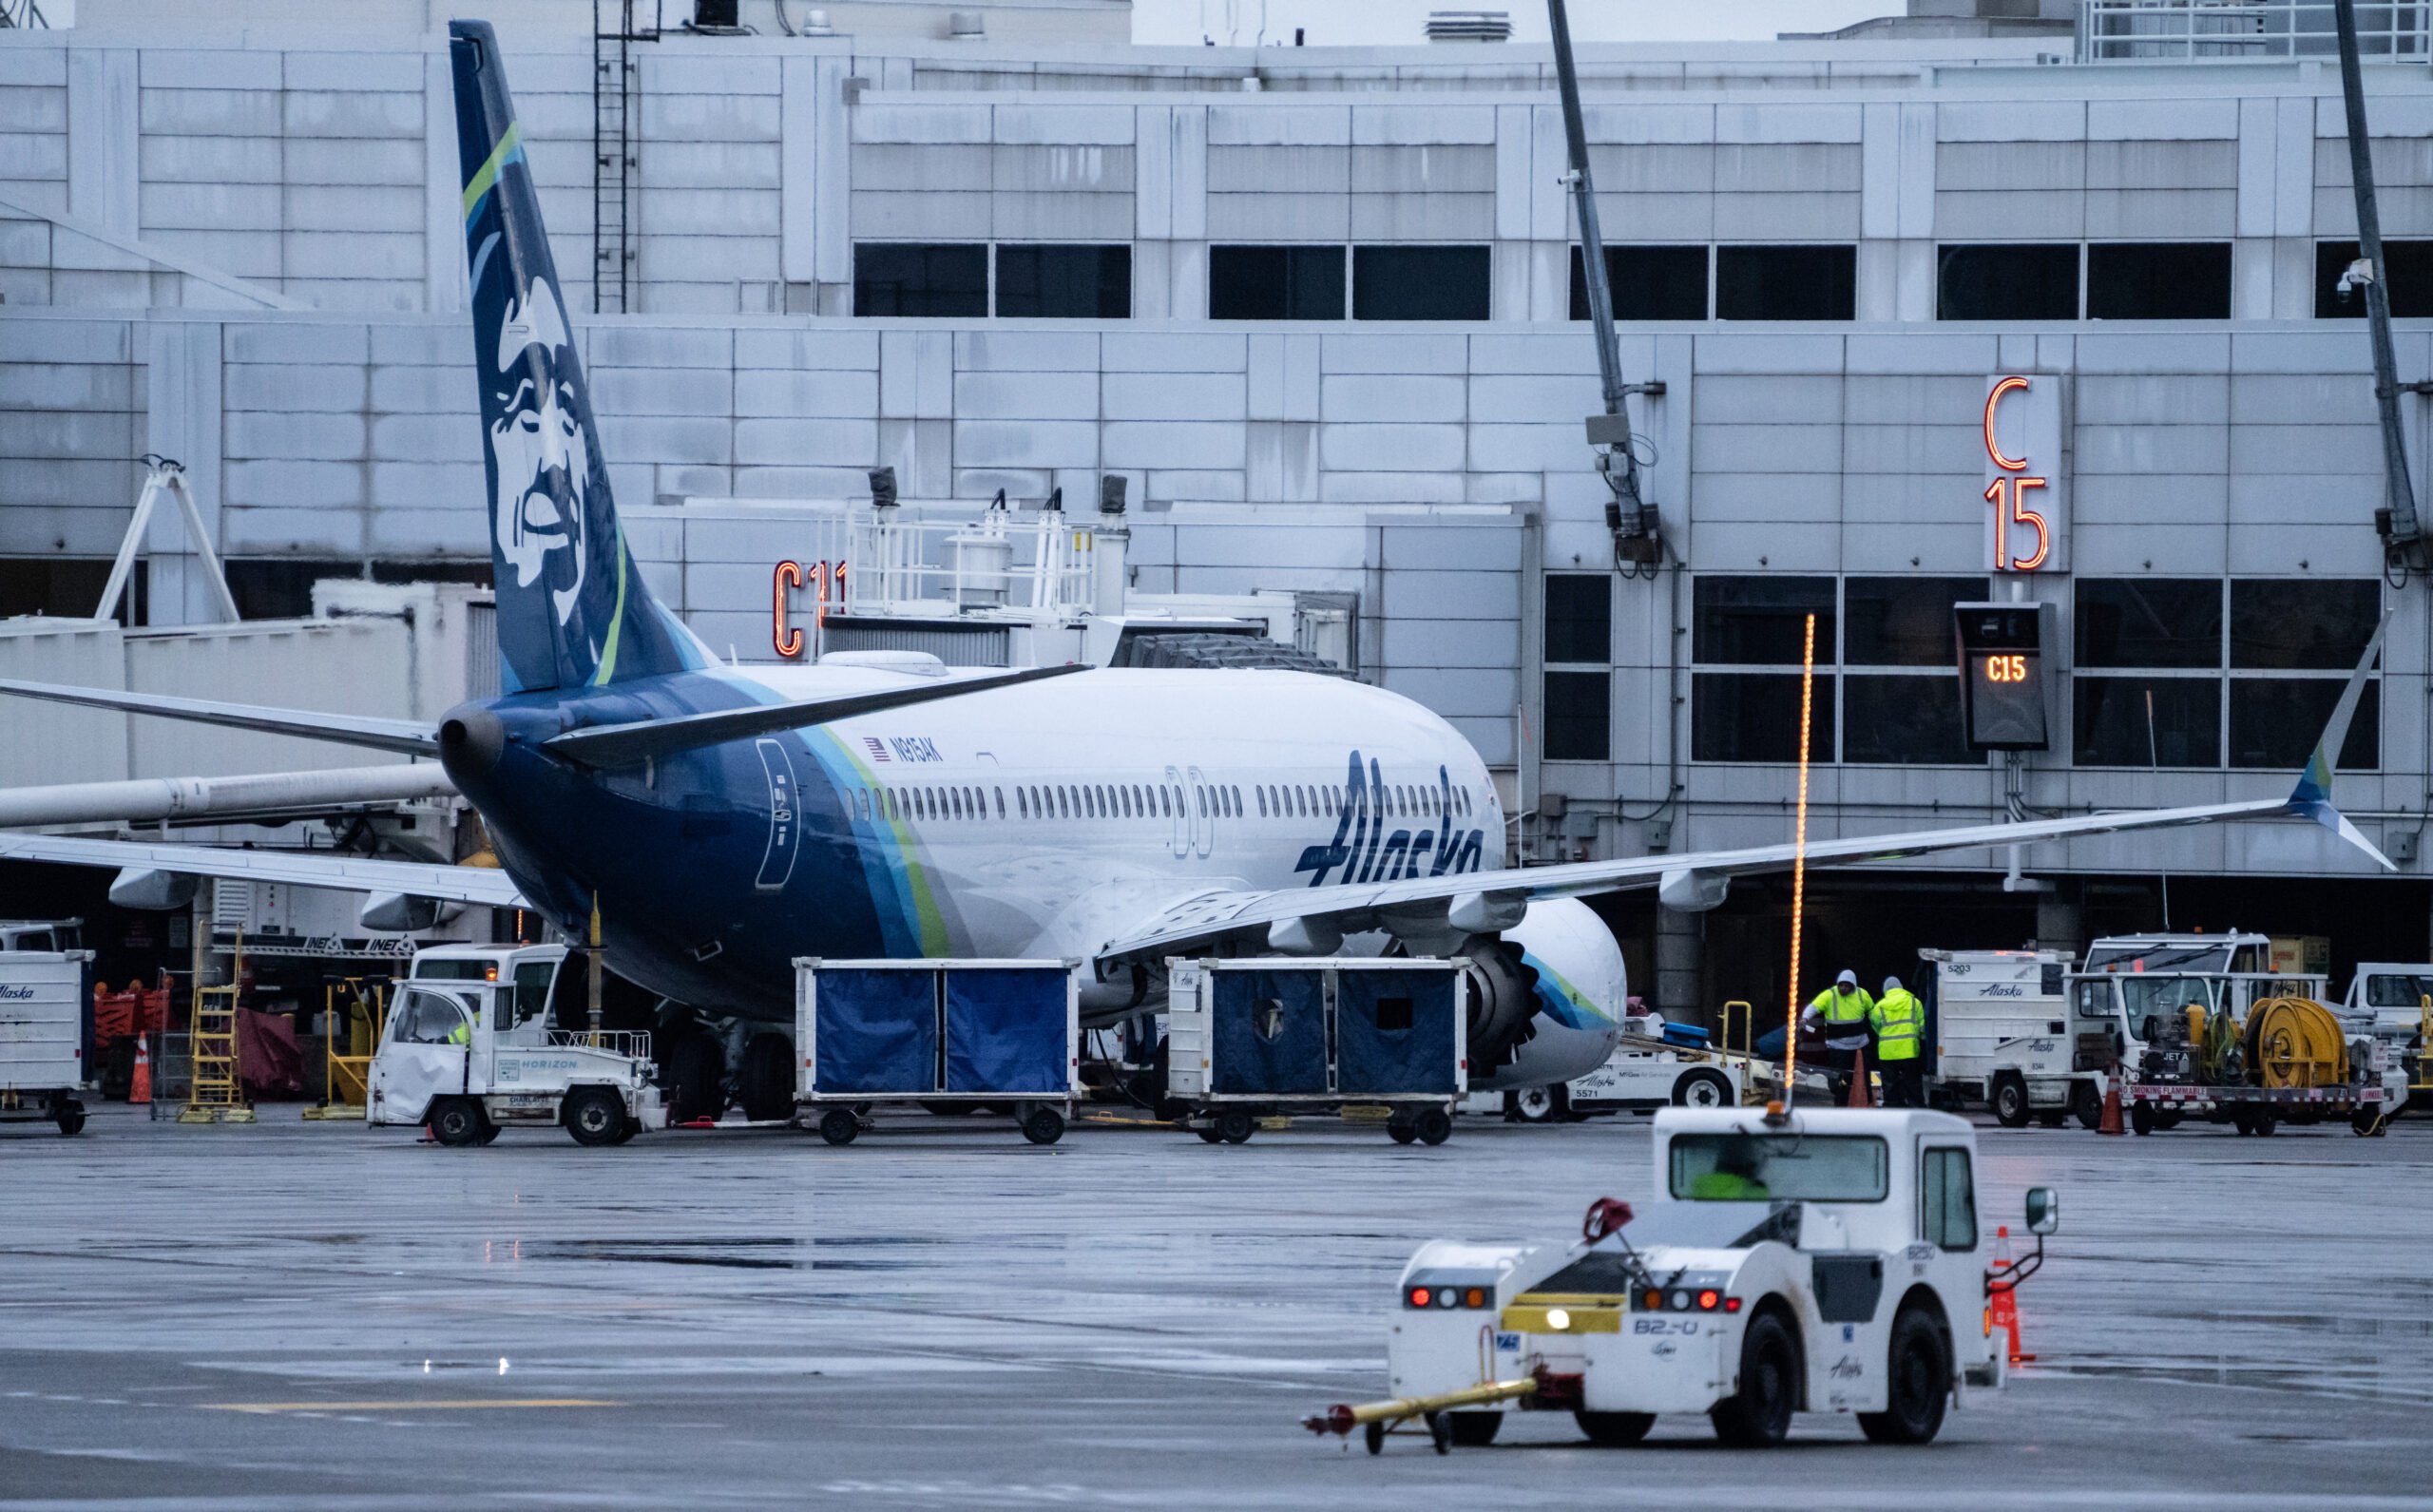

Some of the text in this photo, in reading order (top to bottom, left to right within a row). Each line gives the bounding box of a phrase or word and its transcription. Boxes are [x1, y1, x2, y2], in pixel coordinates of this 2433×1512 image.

[1984, 376, 2028, 470] C
[1984, 477, 2049, 570] 15
[1986, 656, 2026, 681] C15
[889, 737, 943, 762] N915AK
[0, 985, 34, 1000] laska
[1980, 984, 2022, 997] Alaska
[2163, 1052, 2179, 1061] JET
[1576, 1074, 1616, 1088] Alaska
[2130, 1086, 2162, 1095] SMOKING
[2163, 1086, 2206, 1095] FLAMMABLE
